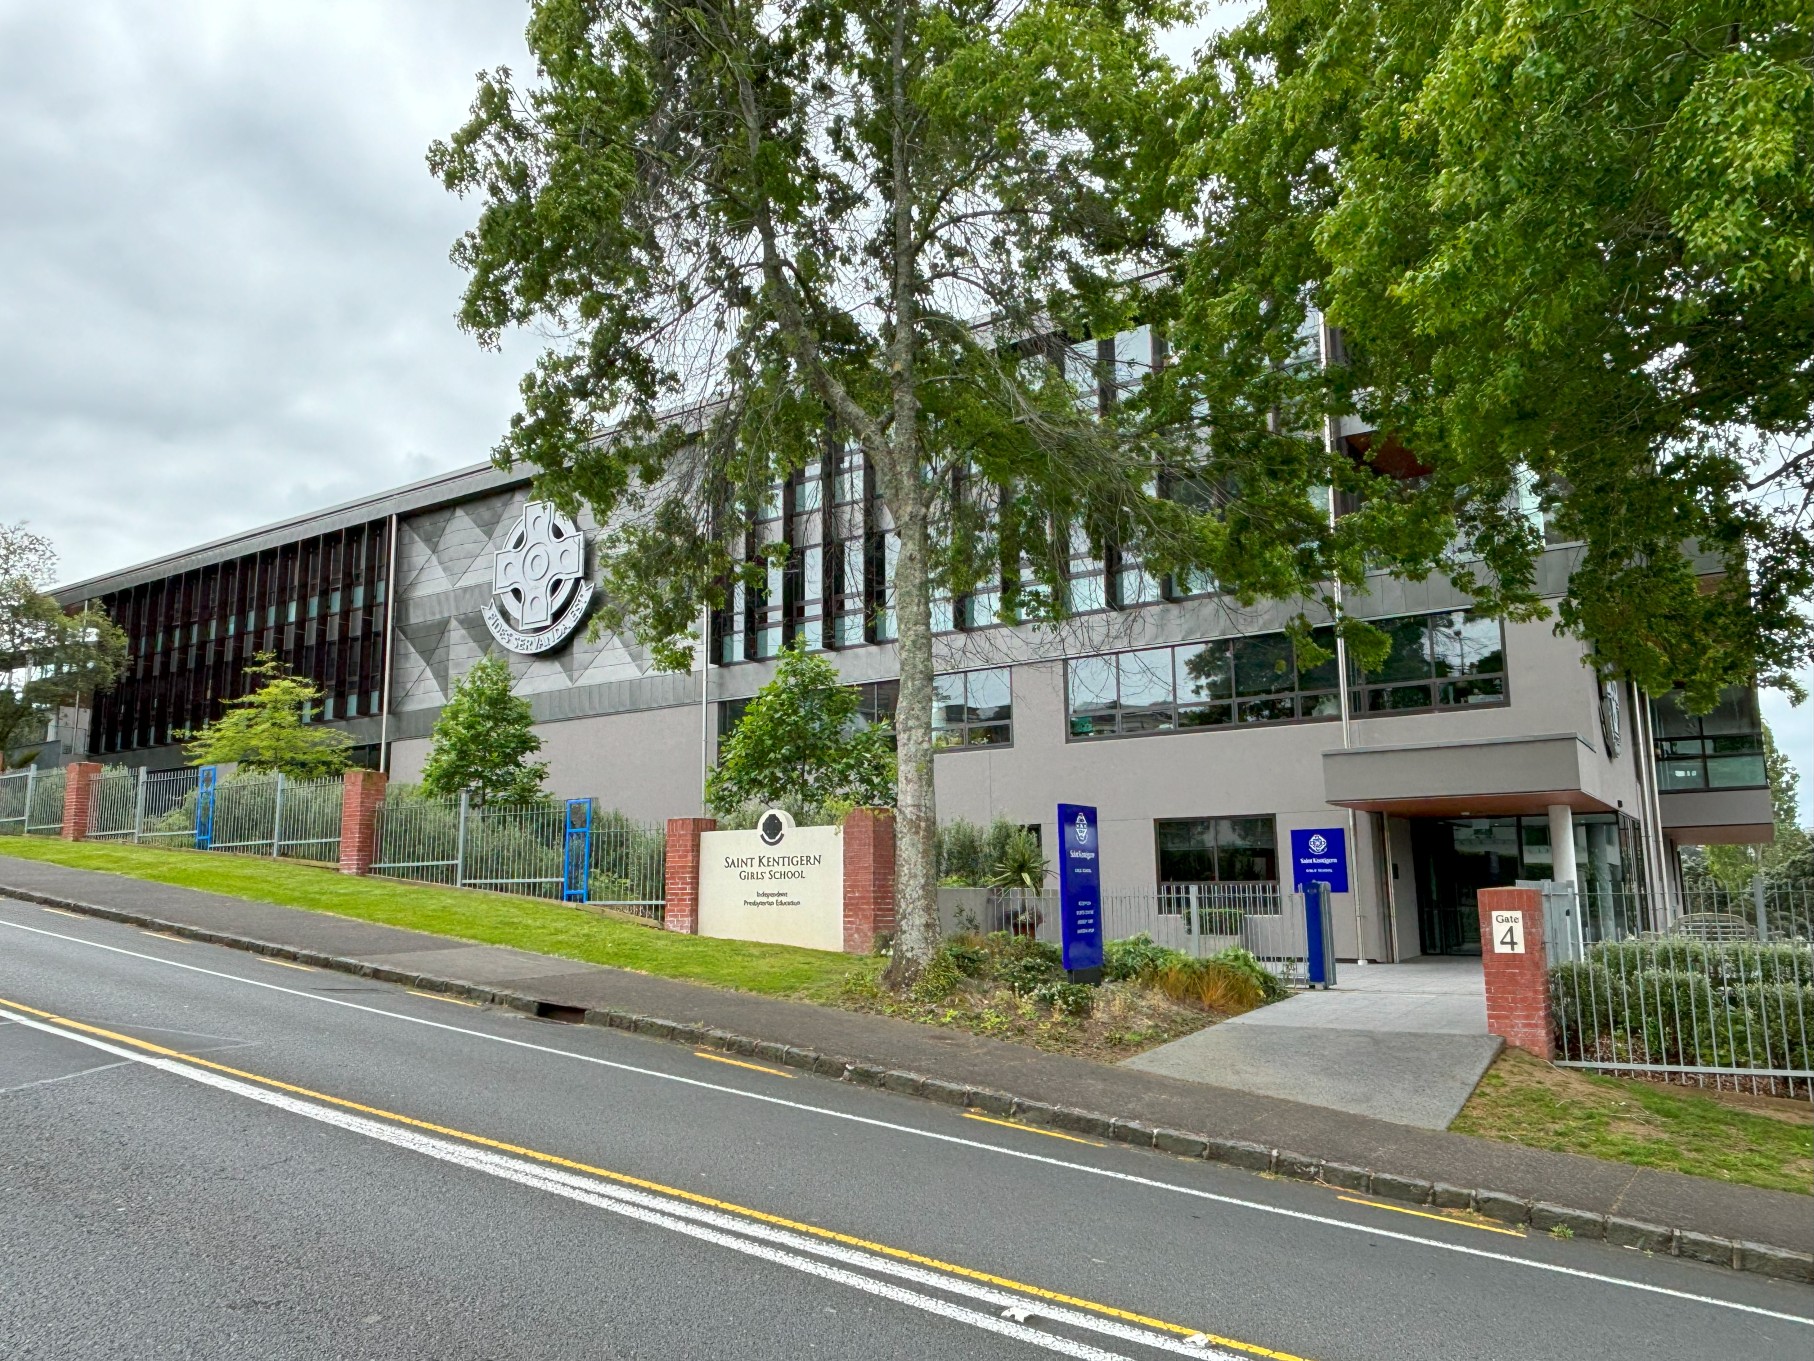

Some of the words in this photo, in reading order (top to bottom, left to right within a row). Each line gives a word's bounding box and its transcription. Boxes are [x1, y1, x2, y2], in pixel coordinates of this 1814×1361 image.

[768, 869, 805, 880] SCHOOL
[756, 891, 788, 899] Independent
[743, 899, 774, 907] Presbyterian
[1495, 914, 1519, 923] Gate
[1499, 925, 1518, 951] 4
